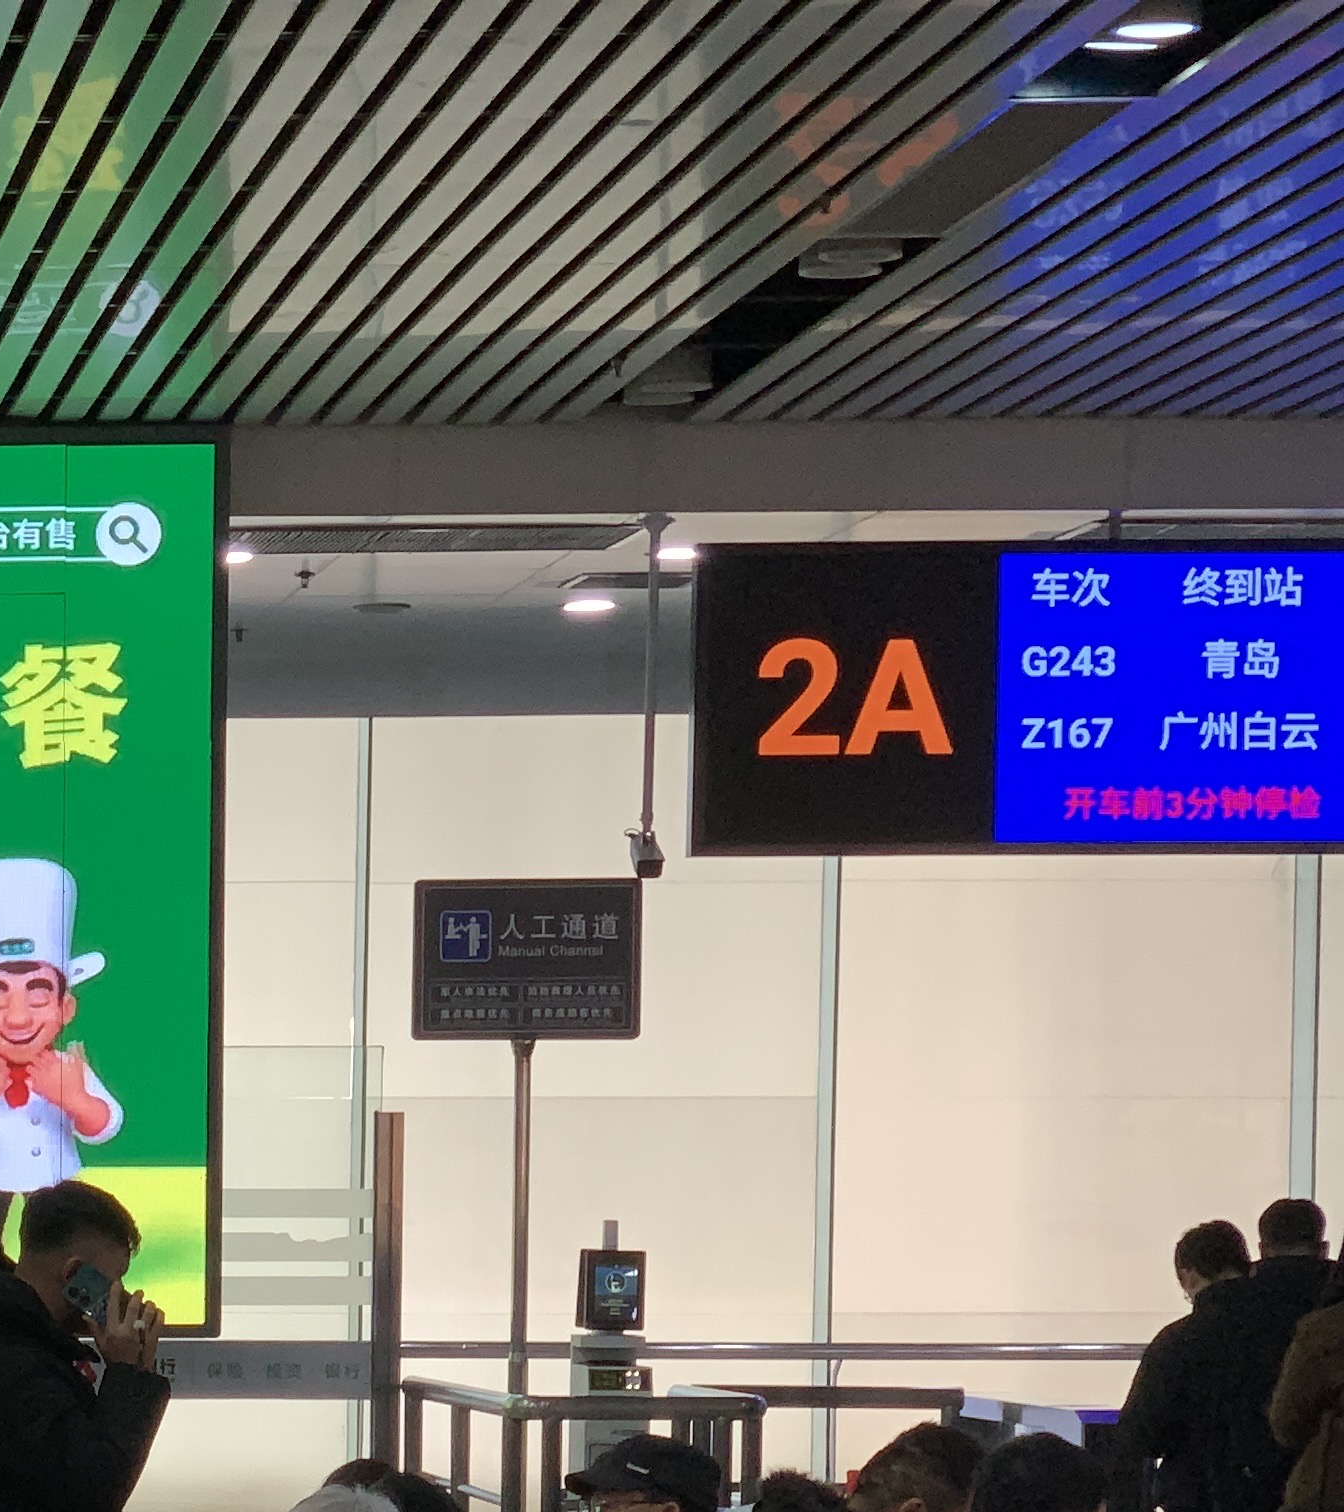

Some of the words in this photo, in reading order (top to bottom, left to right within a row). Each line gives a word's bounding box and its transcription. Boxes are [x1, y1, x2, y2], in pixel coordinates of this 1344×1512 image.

[1031, 567, 1111, 607] 车次
[1182, 566, 1304, 607] 终到站
[1022, 645, 1116, 677] G243
[1201, 638, 1280, 679] 青岛
[758, 637, 953, 756] 2A
[1021, 717, 1113, 749] Z167
[1159, 710, 1319, 751] 广州白云
[1063, 786, 1321, 820] 开车前3分钟停检
[499, 912, 619, 940] 人工通道
[497, 944, 546, 957] Manual
[550, 943, 604, 956] Channel
